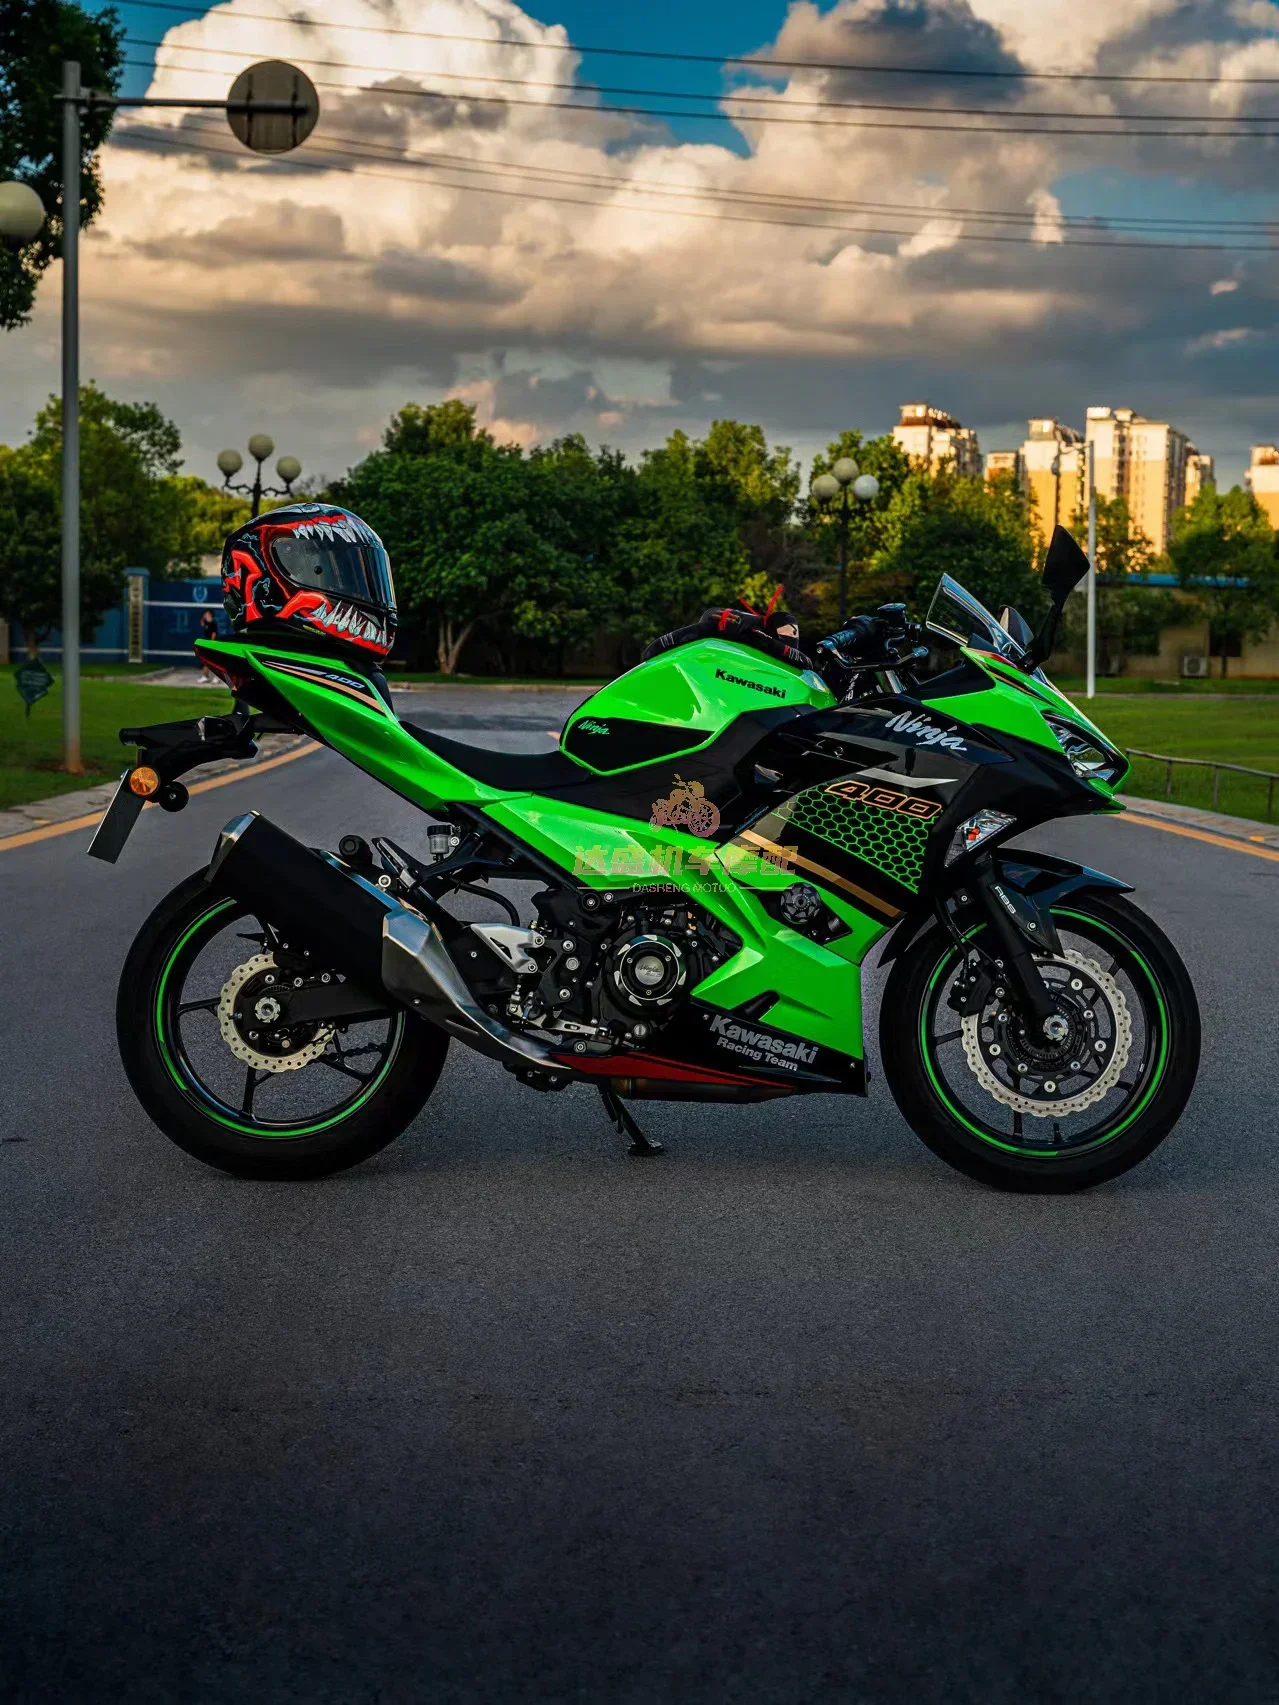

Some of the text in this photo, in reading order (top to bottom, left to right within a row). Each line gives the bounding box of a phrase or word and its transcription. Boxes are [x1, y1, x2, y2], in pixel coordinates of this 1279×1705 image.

[325, 674, 365, 689] 400
[715, 668, 787, 700] Kawasaki
[577, 720, 610, 735] Ninja
[884, 710, 968, 752] Ninja
[824, 780, 943, 820] 400
[994, 885, 1017, 914] ABS
[709, 1014, 820, 1064] Kawasaki
[716, 1036, 799, 1072] Racing Team
